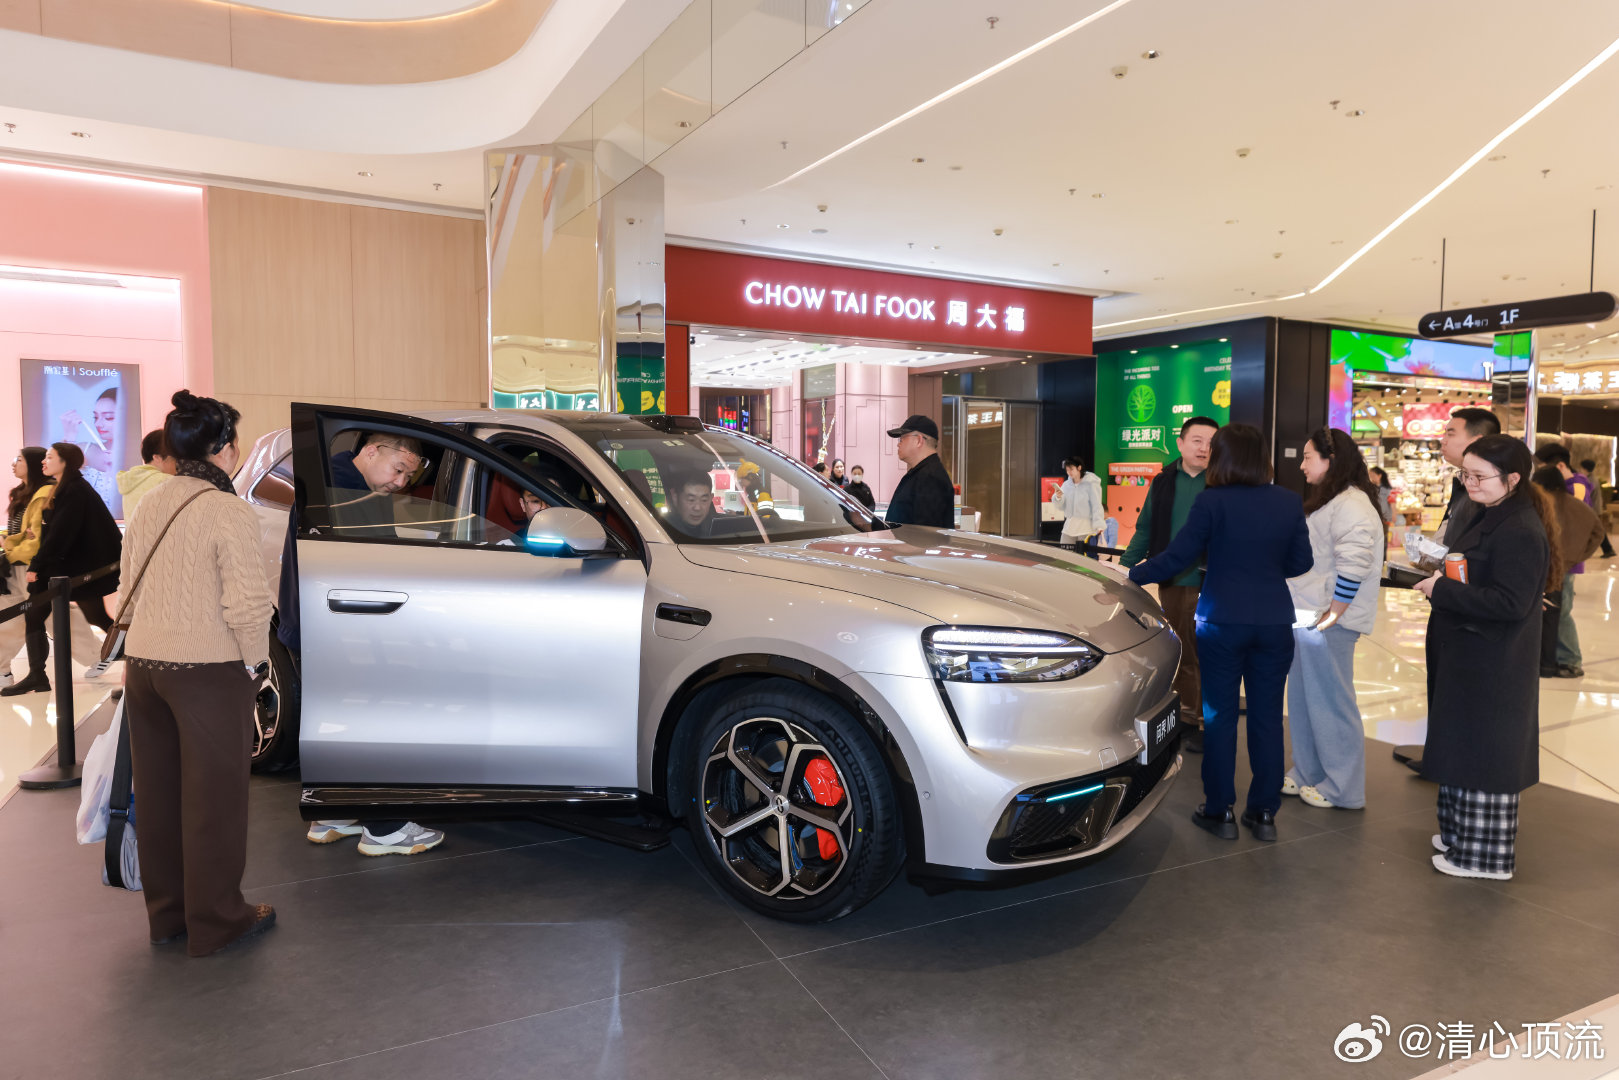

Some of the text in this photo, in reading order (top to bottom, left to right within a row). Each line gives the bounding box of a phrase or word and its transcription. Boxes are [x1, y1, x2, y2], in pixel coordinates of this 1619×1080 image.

[745, 281, 936, 321] CHOW TAI FOOK
[947, 300, 1025, 332] 周大福
[1500, 308, 1519, 325] 1F
[79, 367, 118, 377] Soufflé
[1172, 404, 1193, 414] OPEN
[1122, 429, 1161, 442] 绿光派对
